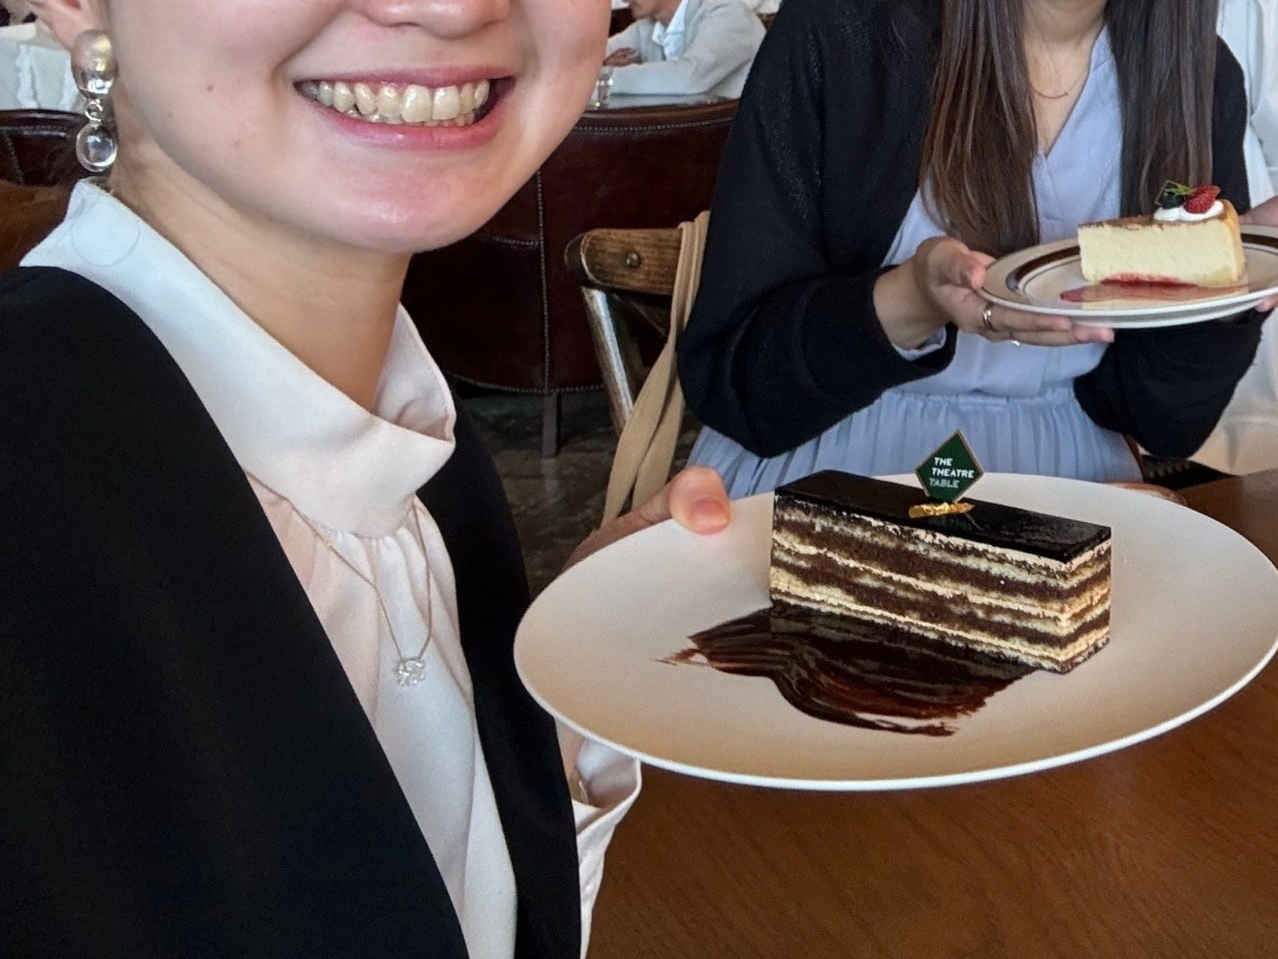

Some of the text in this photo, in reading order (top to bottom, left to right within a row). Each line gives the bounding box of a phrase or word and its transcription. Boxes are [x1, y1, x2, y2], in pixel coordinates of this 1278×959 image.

[934, 457, 953, 466] THE
[932, 467, 975, 478] THEATRE
[929, 478, 960, 488] TABLE
